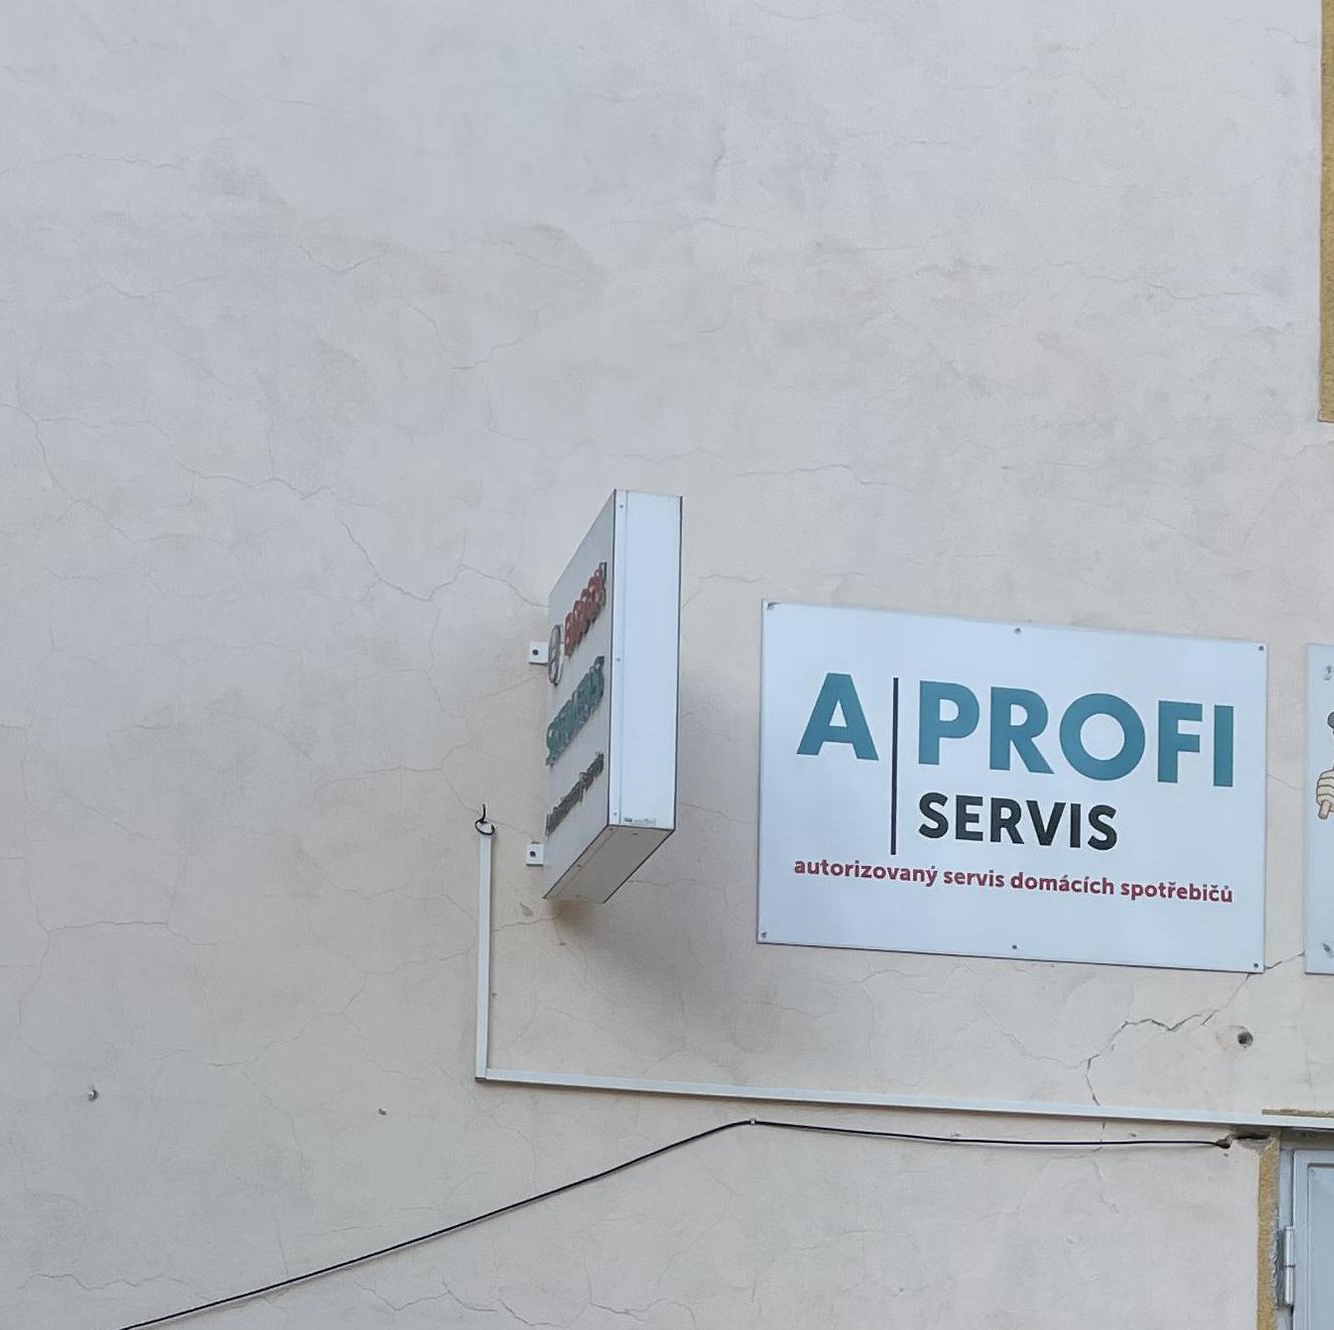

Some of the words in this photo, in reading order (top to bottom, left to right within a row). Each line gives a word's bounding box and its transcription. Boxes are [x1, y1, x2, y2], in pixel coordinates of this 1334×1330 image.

[797, 673, 879, 761] A
[918, 680, 1234, 788] PROFI
[918, 792, 1118, 851] SERVIS
[794, 858, 938, 888] autorizovaný
[943, 868, 1005, 890] servis
[1010, 872, 1115, 896] domácích
[1120, 880, 1233, 904] spotřebičů
